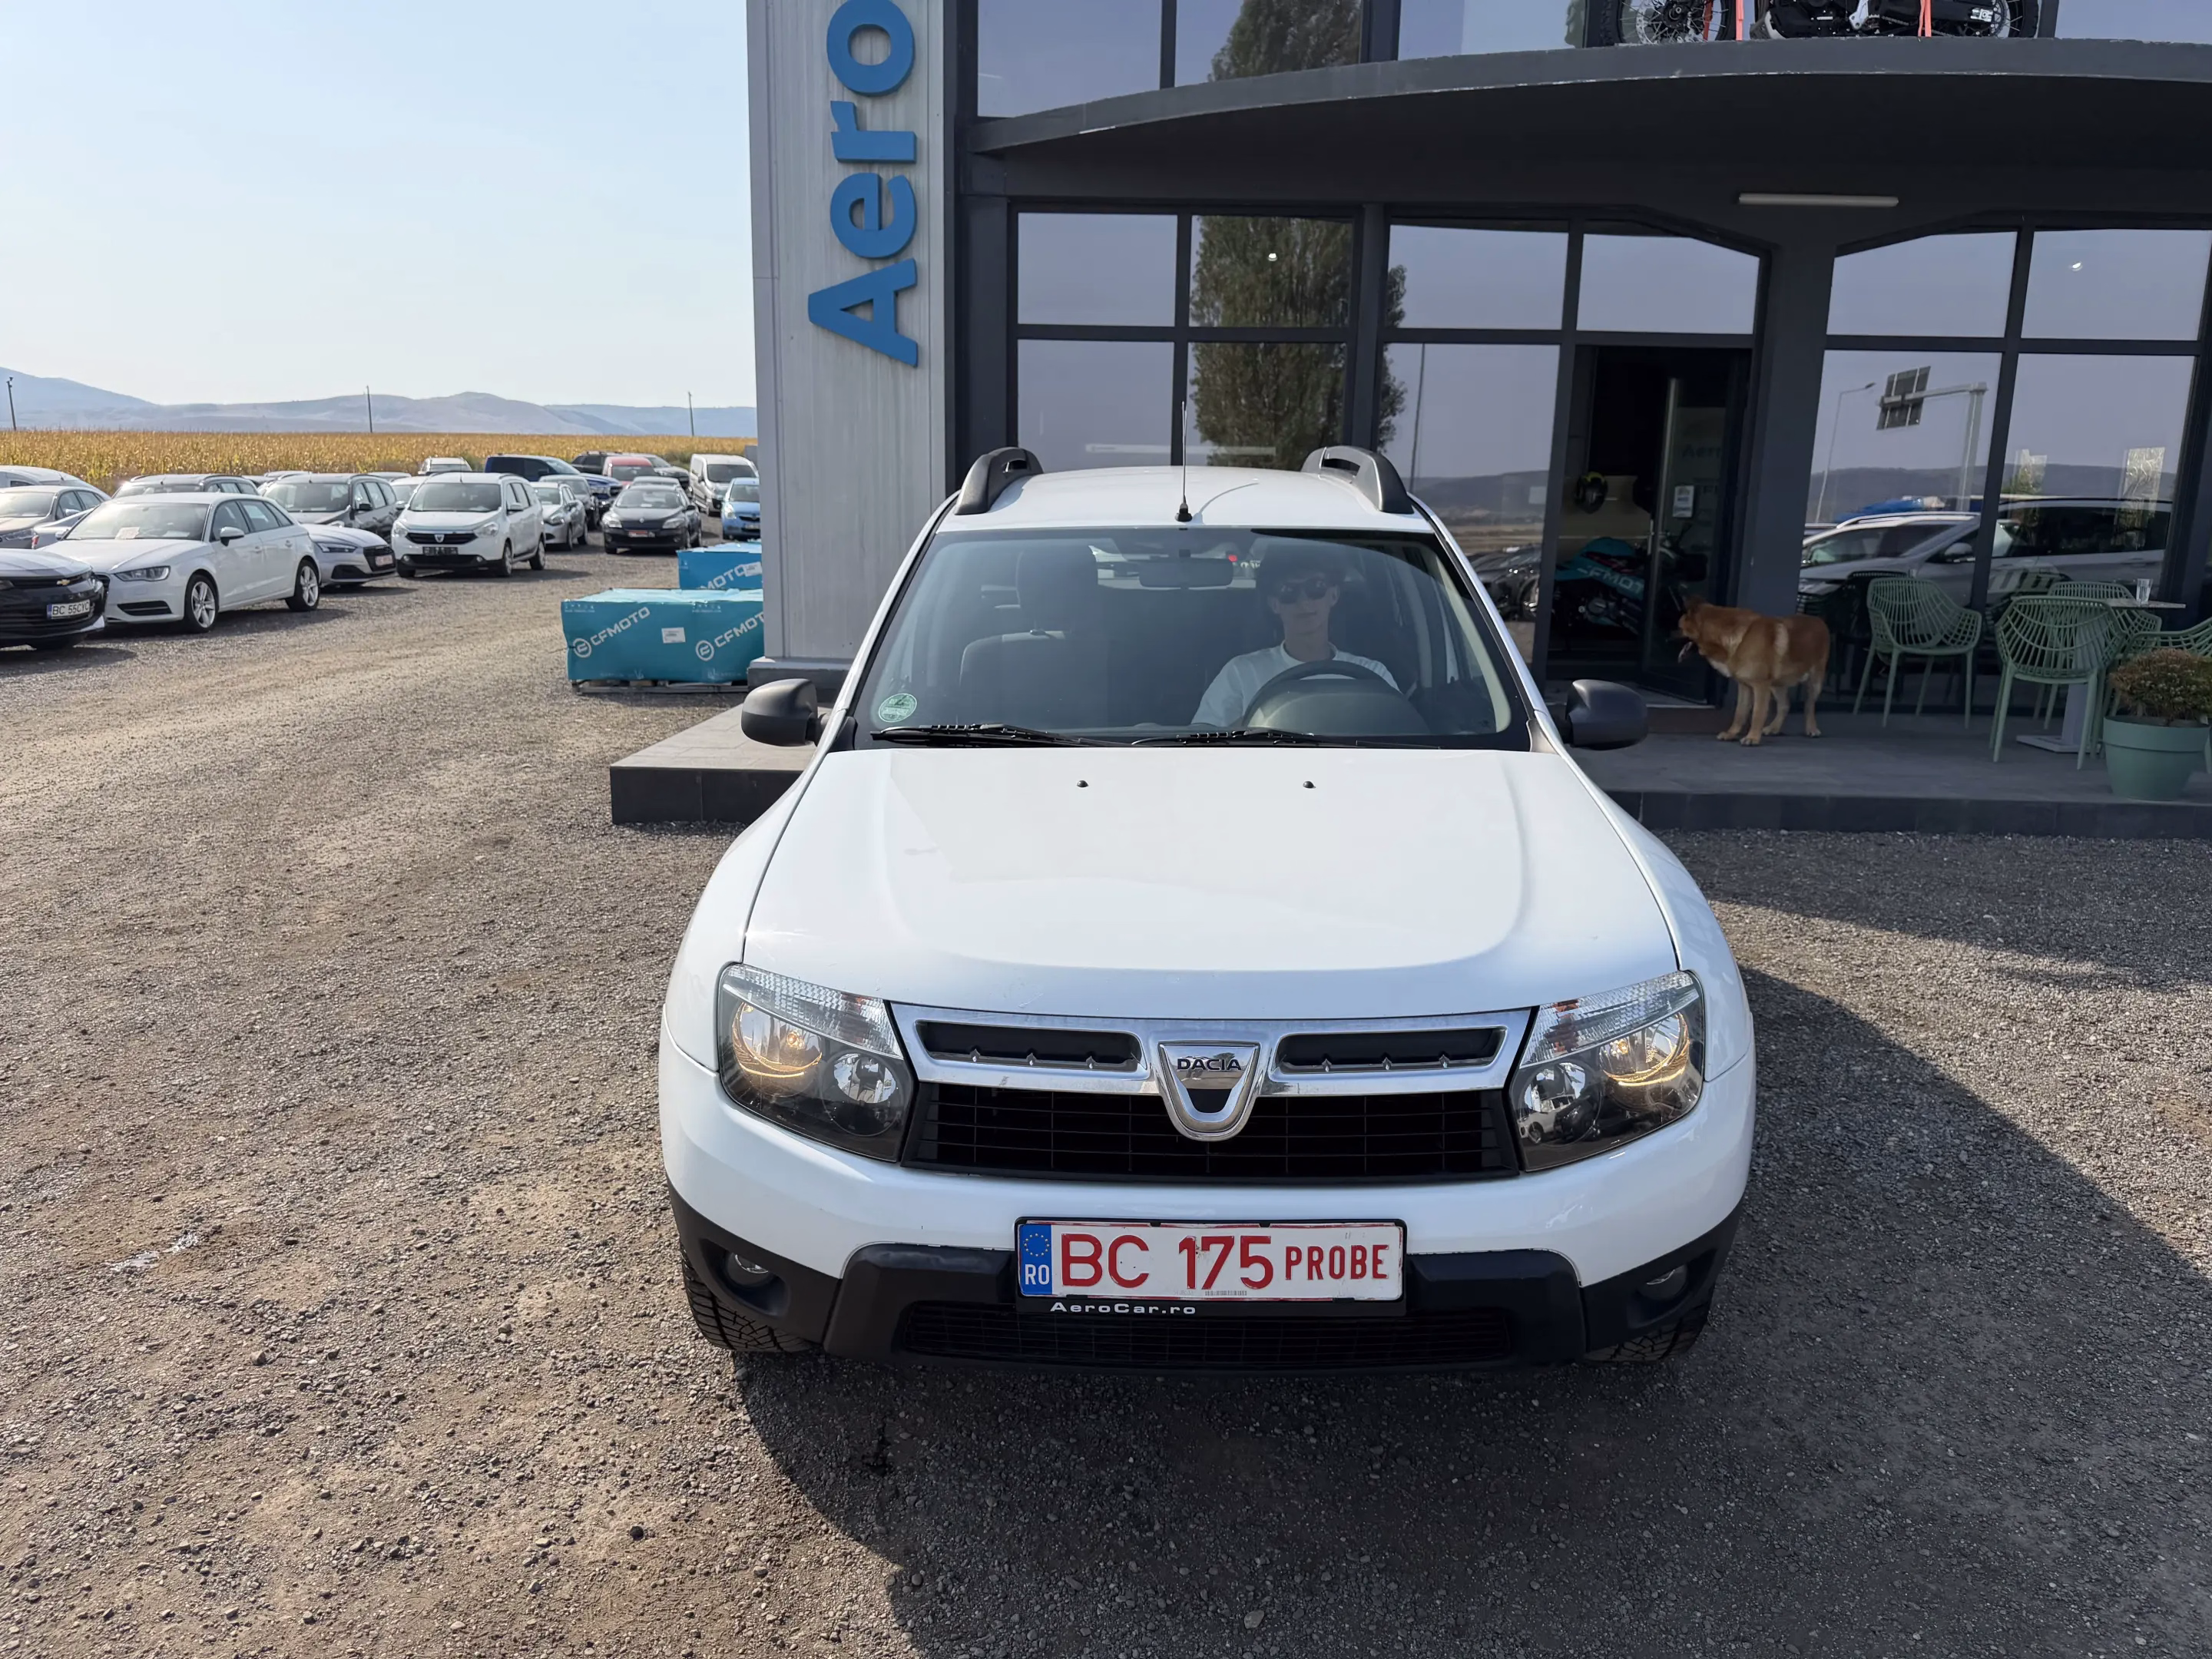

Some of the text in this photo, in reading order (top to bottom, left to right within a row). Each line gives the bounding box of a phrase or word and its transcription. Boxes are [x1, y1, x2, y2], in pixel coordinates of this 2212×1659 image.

[808, 0, 919, 368] Aero
[52, 605, 65, 615] BC
[590, 606, 651, 646] CFMOTO
[714, 611, 765, 647] CFMOT
[1177, 1058, 1242, 1071] DACIA
[1024, 1263, 1051, 1286] RO
[1061, 1233, 1389, 1290] BC 175 PROBE
[1049, 1301, 1197, 1315] AeroCar.ro
